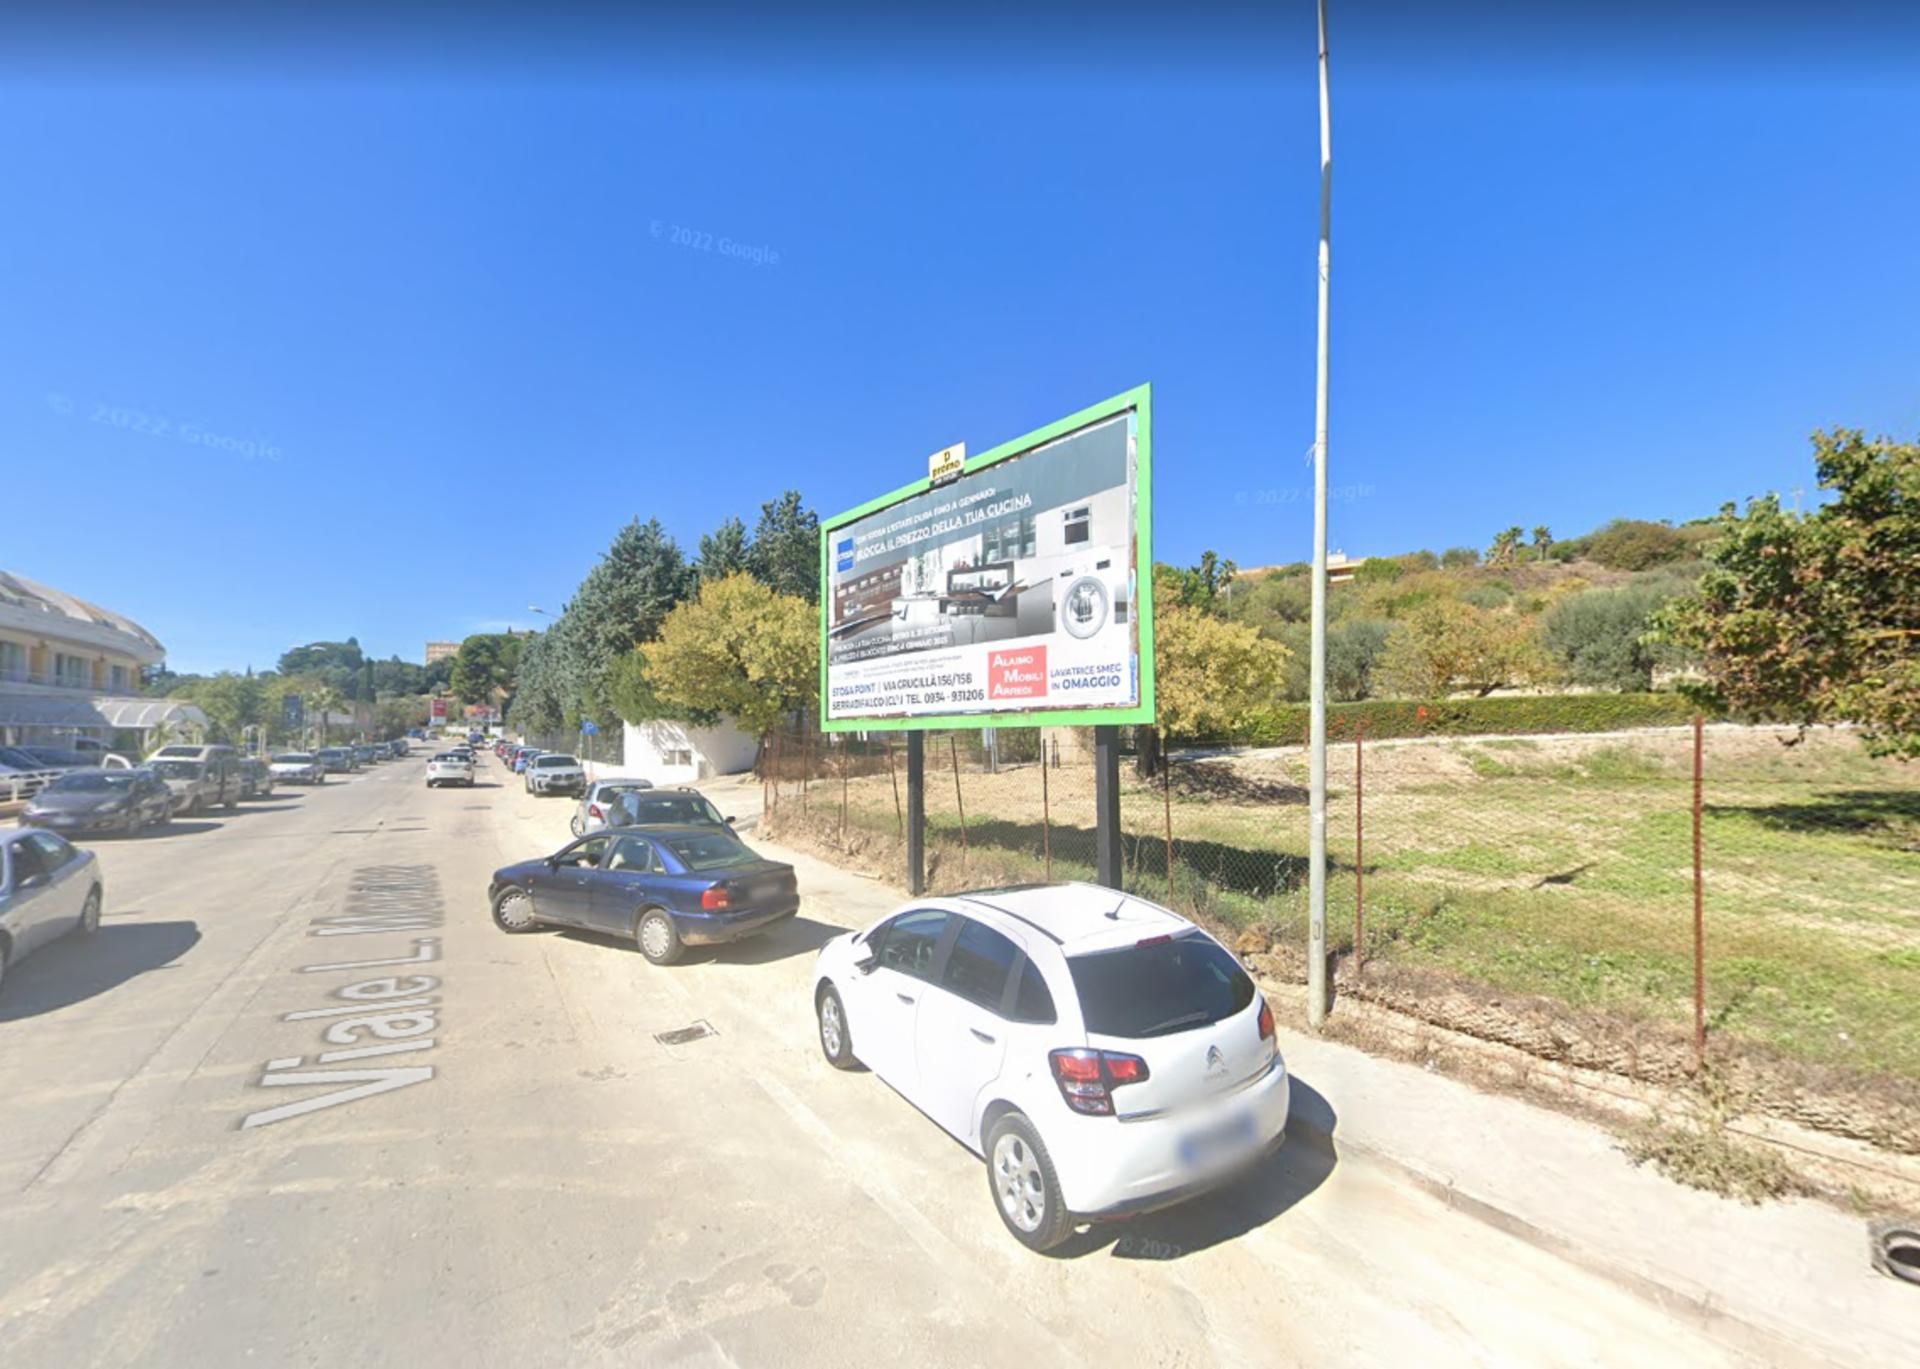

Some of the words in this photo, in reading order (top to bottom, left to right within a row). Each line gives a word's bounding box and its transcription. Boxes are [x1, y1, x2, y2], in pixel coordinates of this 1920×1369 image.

[896, 526, 930, 549] PREZZO
[931, 516, 963, 536] DELLA
[965, 507, 985, 526] TUA
[986, 493, 1032, 518] CUCINA
[1004, 669, 1044, 684] MOBILI
[1050, 665, 1095, 679] LAVATRICE
[1097, 663, 1122, 674] SMEG
[855, 683, 875, 695] POINT
[883, 680, 896, 692] VIA
[938, 671, 973, 688] 156/158
[1051, 681, 1060, 691] IN
[1062, 674, 1121, 691] OMAGGIO
[924, 691, 945, 704] 0934
[951, 689, 984, 703] 931206
